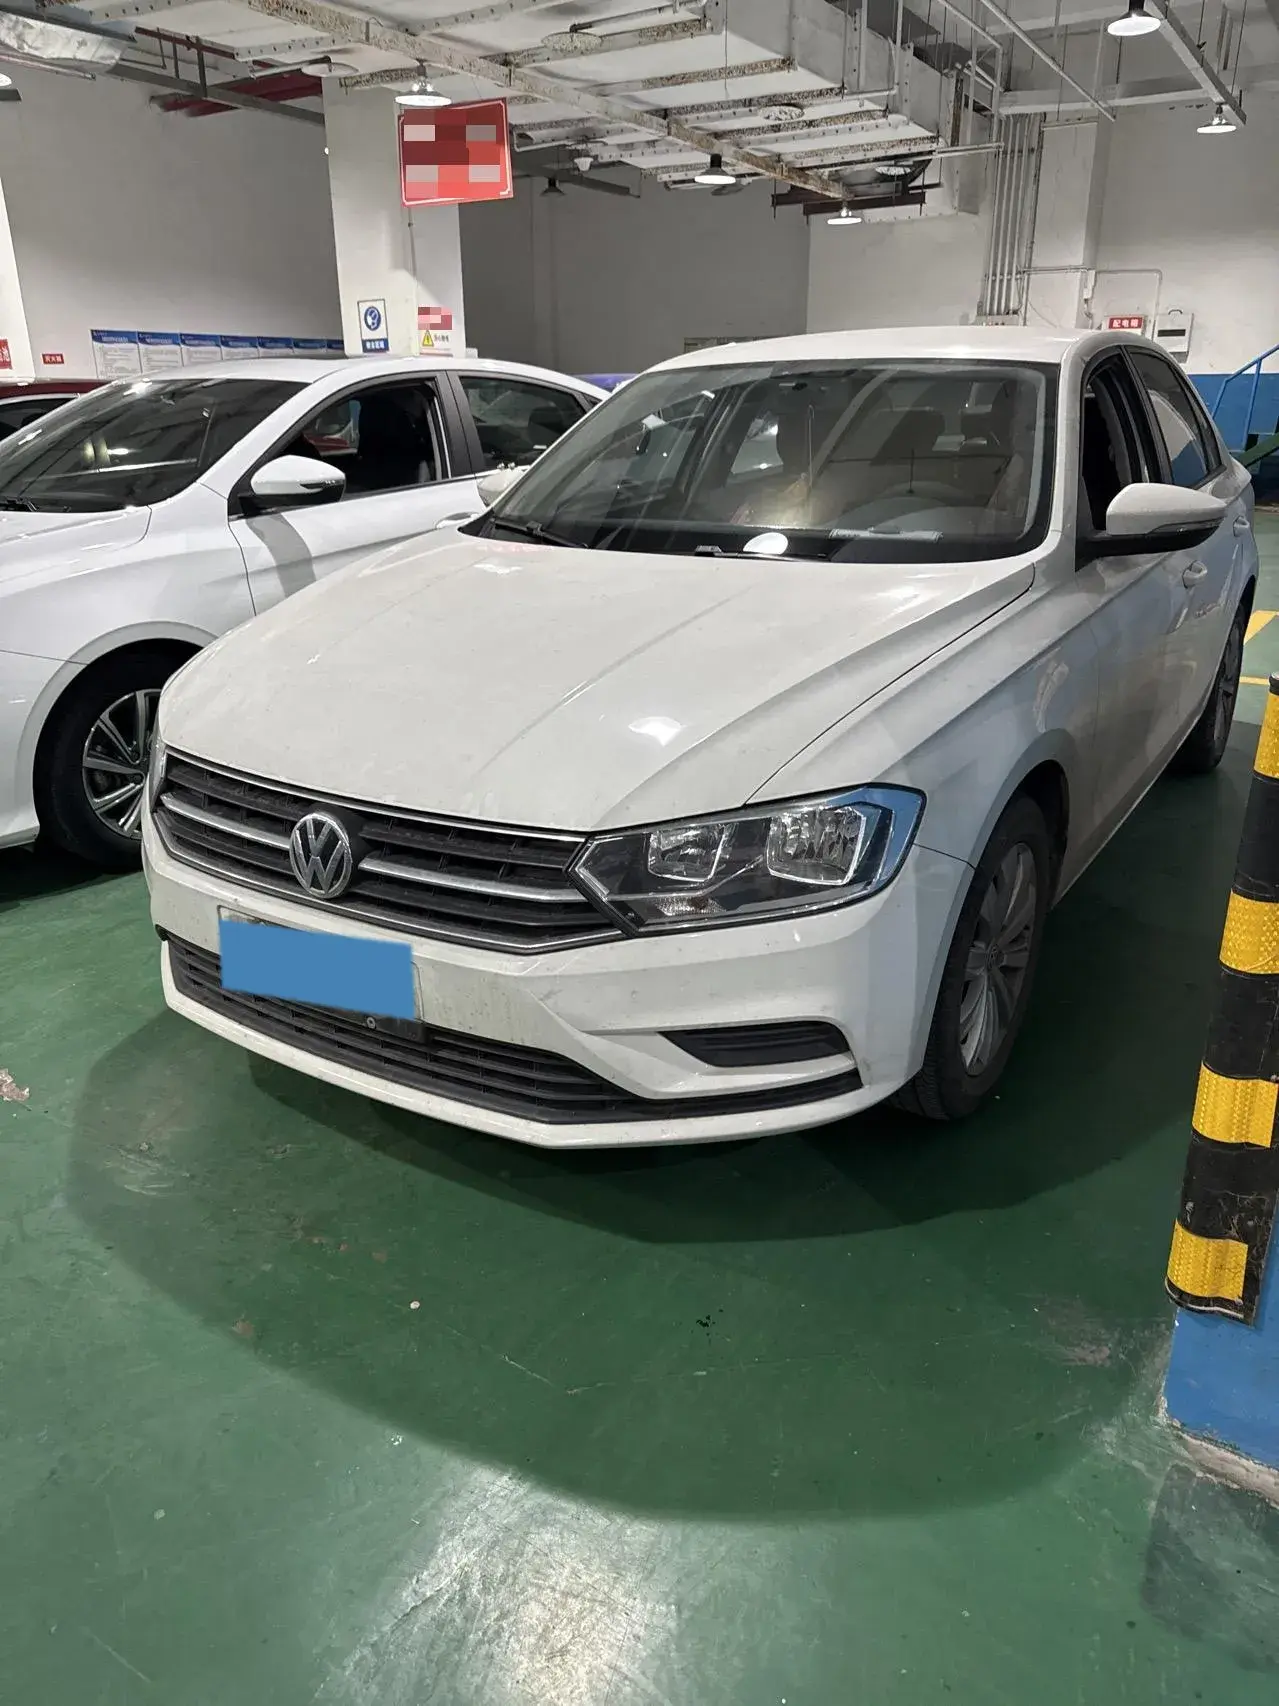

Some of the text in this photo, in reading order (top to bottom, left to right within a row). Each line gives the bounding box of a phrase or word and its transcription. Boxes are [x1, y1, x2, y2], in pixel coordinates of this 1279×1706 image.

[1112, 318, 1138, 327] 配电箱
[292, 816, 347, 895] VW
